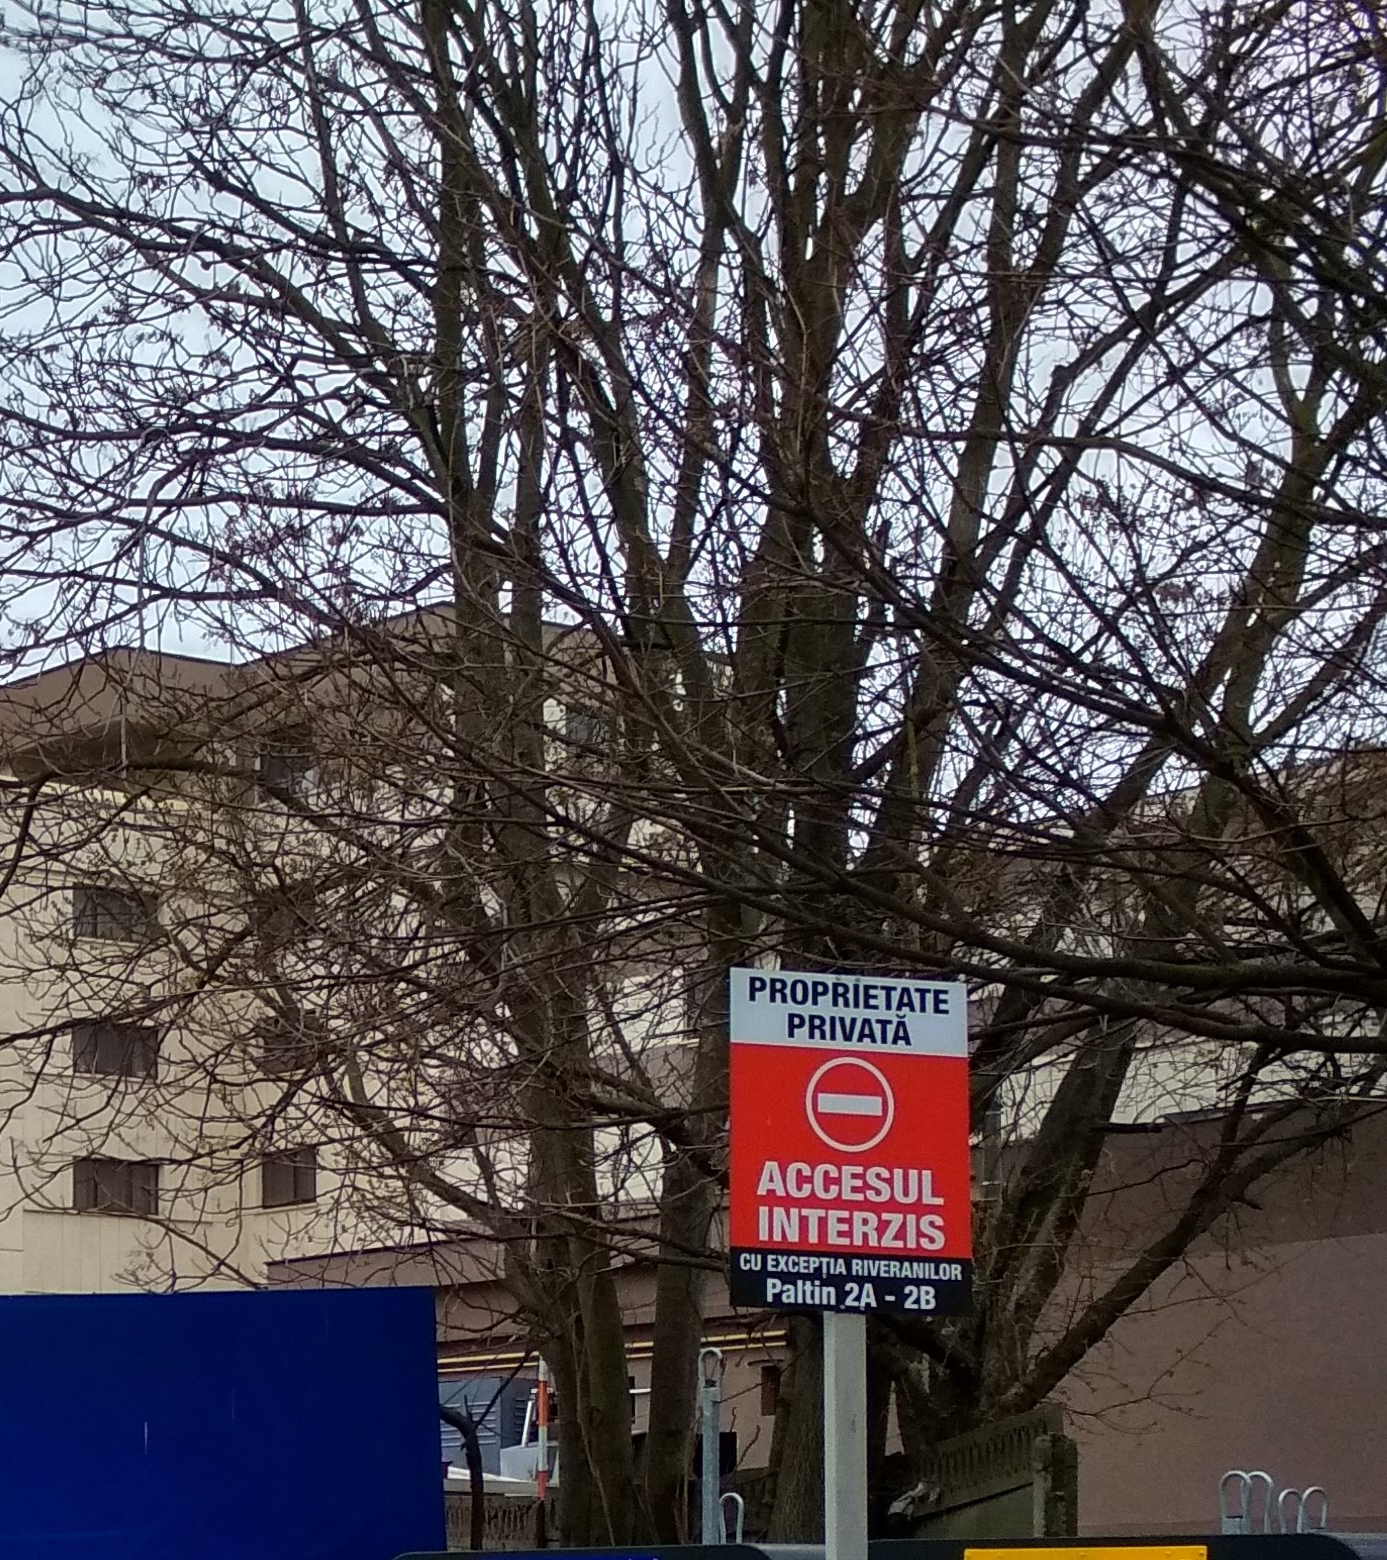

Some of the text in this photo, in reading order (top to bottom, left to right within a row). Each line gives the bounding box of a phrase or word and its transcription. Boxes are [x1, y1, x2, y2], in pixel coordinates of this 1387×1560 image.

[748, 976, 950, 1015] PROPRIETATE
[787, 1013, 913, 1046] PRIVATĂ
[756, 1161, 945, 1205] ACCESUL
[758, 1206, 946, 1250] INTERZIS
[740, 1253, 762, 1271] CU
[851, 1259, 963, 1281] RIVERANILOR
[766, 1278, 837, 1306] Paltin
[844, 1282, 878, 1308] 2A
[903, 1285, 937, 1310] 2B
